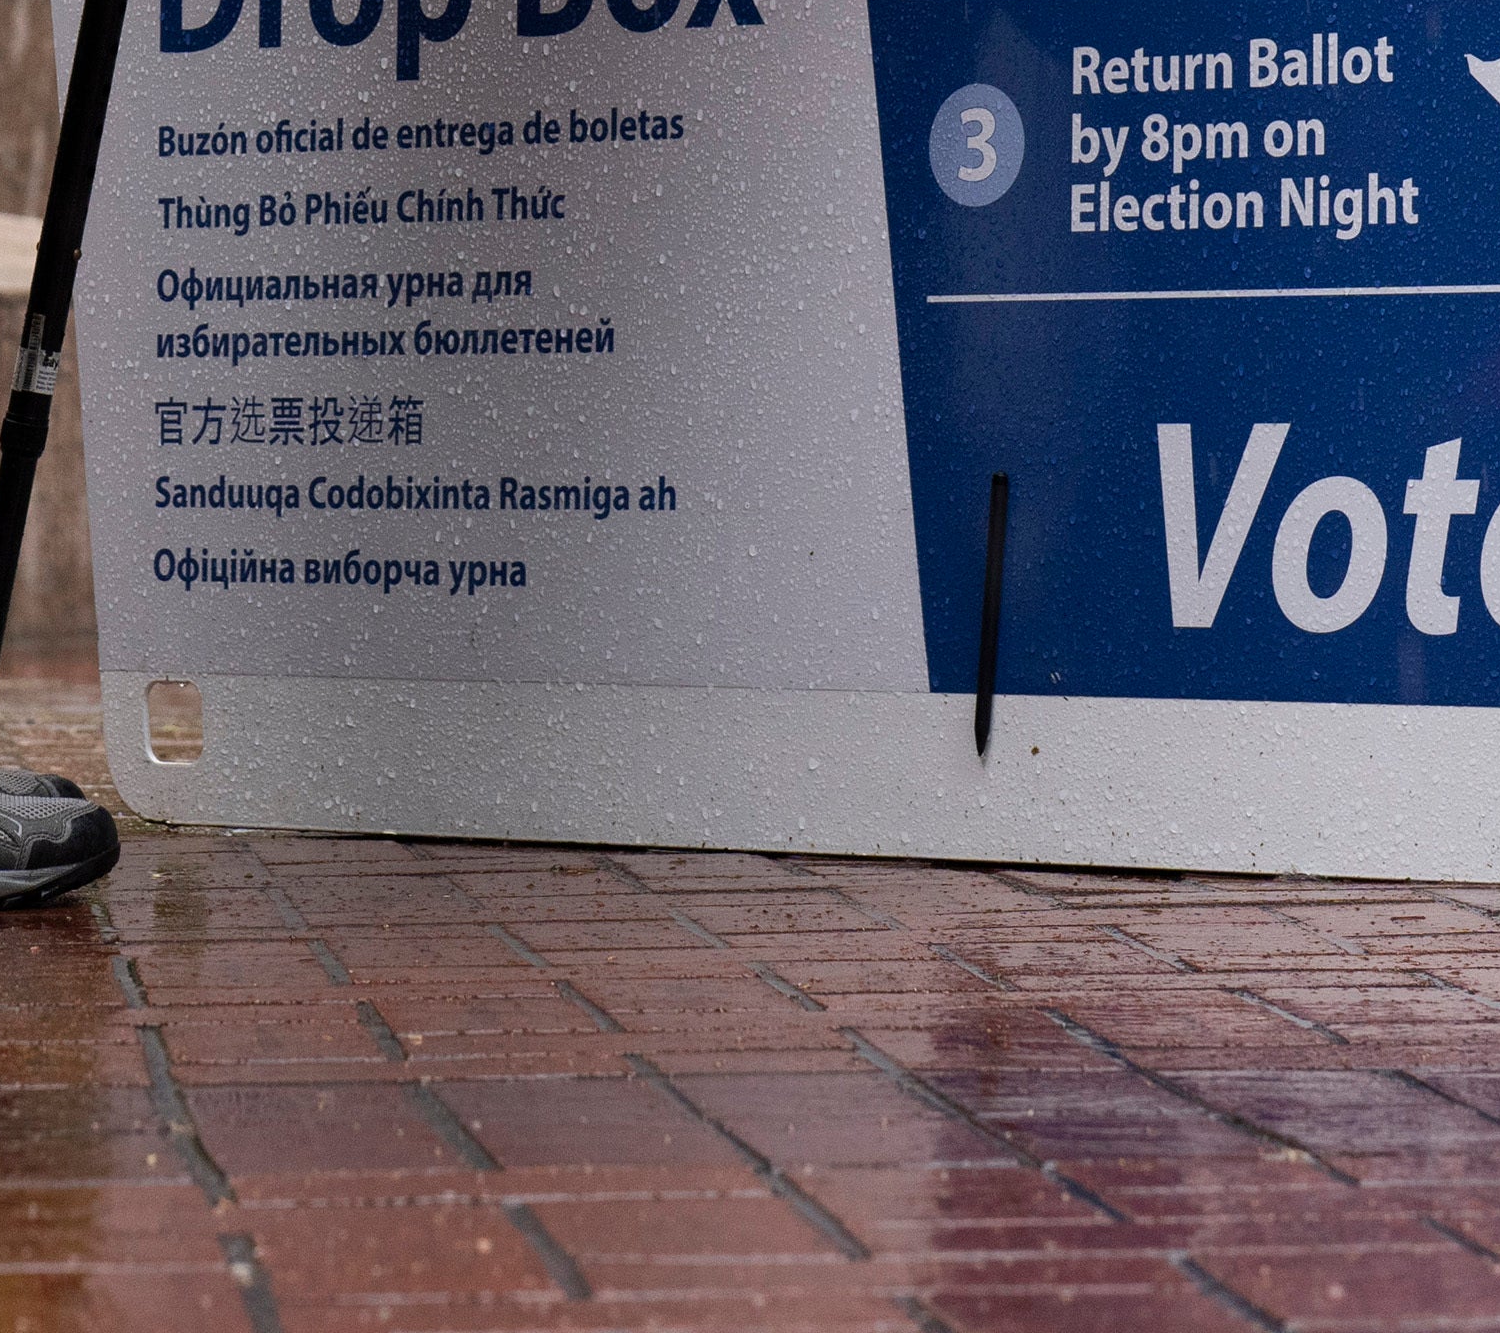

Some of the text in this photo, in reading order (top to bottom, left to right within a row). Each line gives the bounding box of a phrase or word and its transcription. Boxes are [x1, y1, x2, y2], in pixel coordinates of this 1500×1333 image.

[1071, 34, 1397, 98] Return Ballot
[158, 107, 685, 158] Buzón oficial de entrega de boletas
[957, 107, 998, 183] 3
[1071, 112, 1326, 178] by 8pm on
[158, 186, 567, 236] Thùng Bỏ Phiếu Chính Thức
[1069, 173, 1420, 241] Election Night
[156, 268, 533, 311] Официальная урна для
[156, 319, 617, 366] избирательных бюллетеней
[154, 396, 425, 447] 官方选票投递箱
[155, 475, 677, 520] Sanduuqa Codobixinta Rasmiga ah
[154, 548, 527, 595] Офіційна виборча урна
